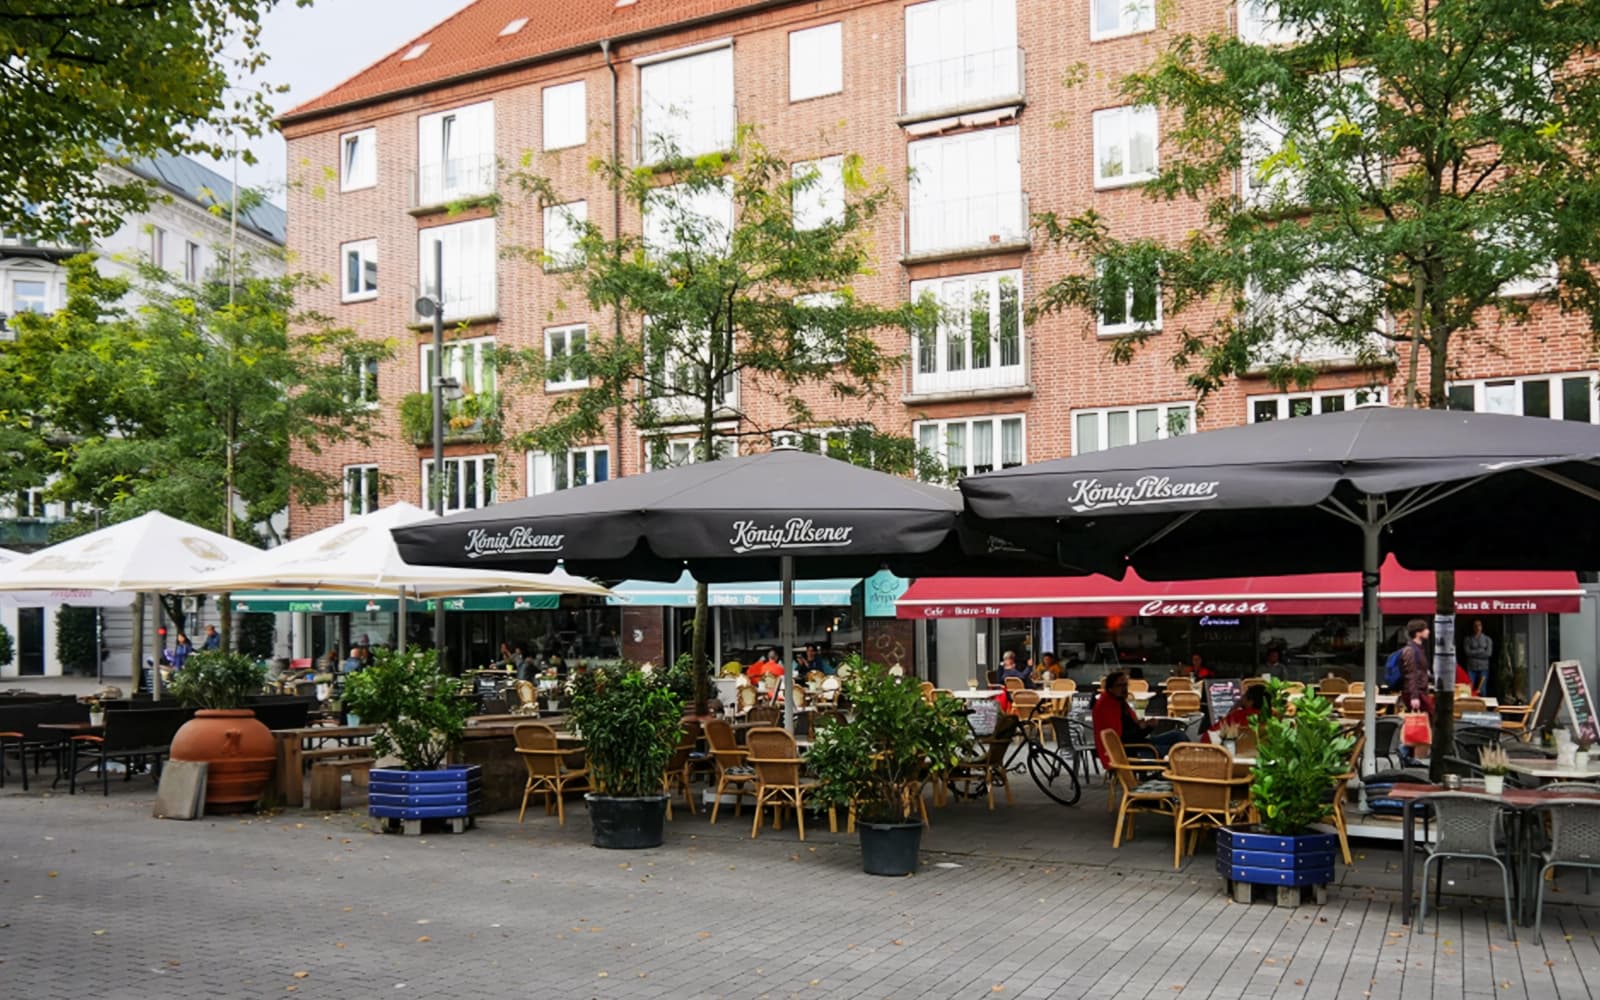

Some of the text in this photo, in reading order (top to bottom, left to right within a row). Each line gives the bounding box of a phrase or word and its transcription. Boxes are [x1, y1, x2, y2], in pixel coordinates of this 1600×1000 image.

[1134, 475, 1220, 500] Pilsener
[509, 526, 565, 548] Pilsener
[783, 517, 853, 543] Pilsener
[1139, 600, 1269, 617] Curiousa
[1493, 600, 1537, 610] Pizzeria
